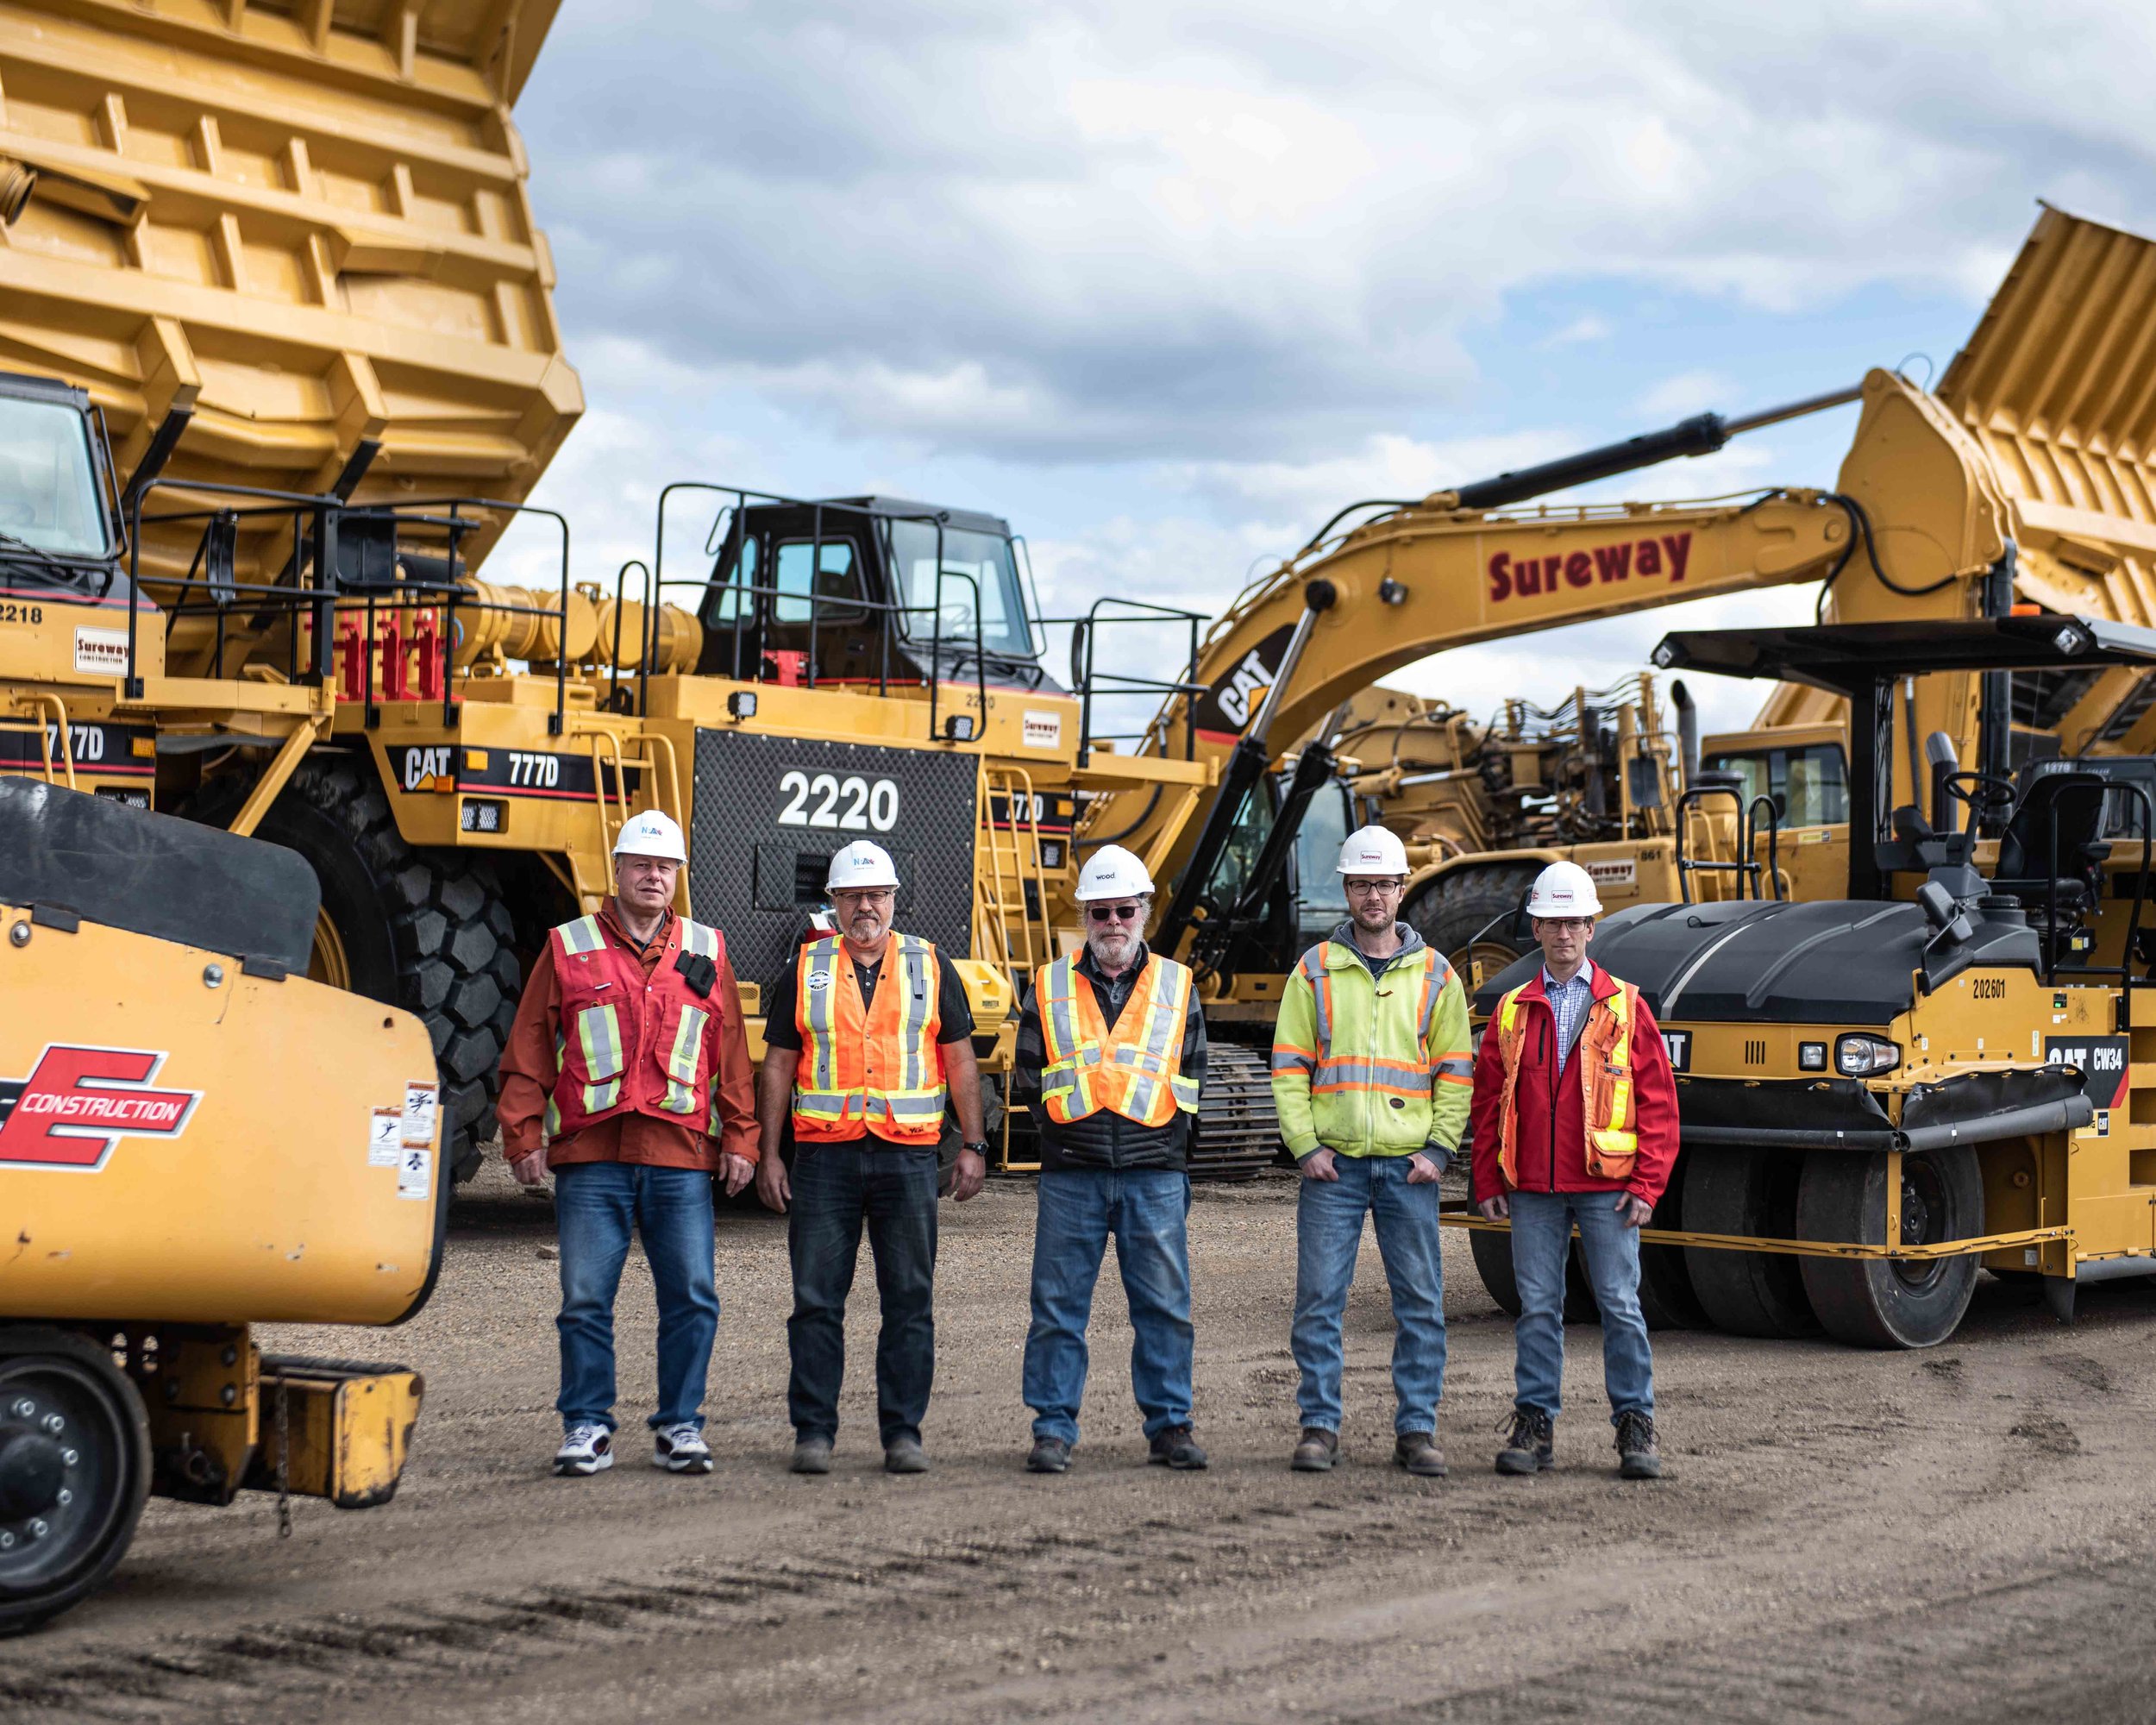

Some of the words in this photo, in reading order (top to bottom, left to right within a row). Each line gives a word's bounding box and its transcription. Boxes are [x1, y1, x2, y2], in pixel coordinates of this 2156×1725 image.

[1489, 531, 1692, 602] Sureway
[78, 655, 123, 664] CONSTRUCTION
[966, 693, 995, 710] 220
[1218, 649, 1274, 727] CAT
[405, 747, 452, 791] CAT
[509, 752, 559, 787] 777D
[778, 770, 899, 831] 2220
[1973, 979, 2005, 999] 202601
[2093, 1047, 2122, 1070] CW34
[20, 1093, 182, 1121] CONSTRUCTION
